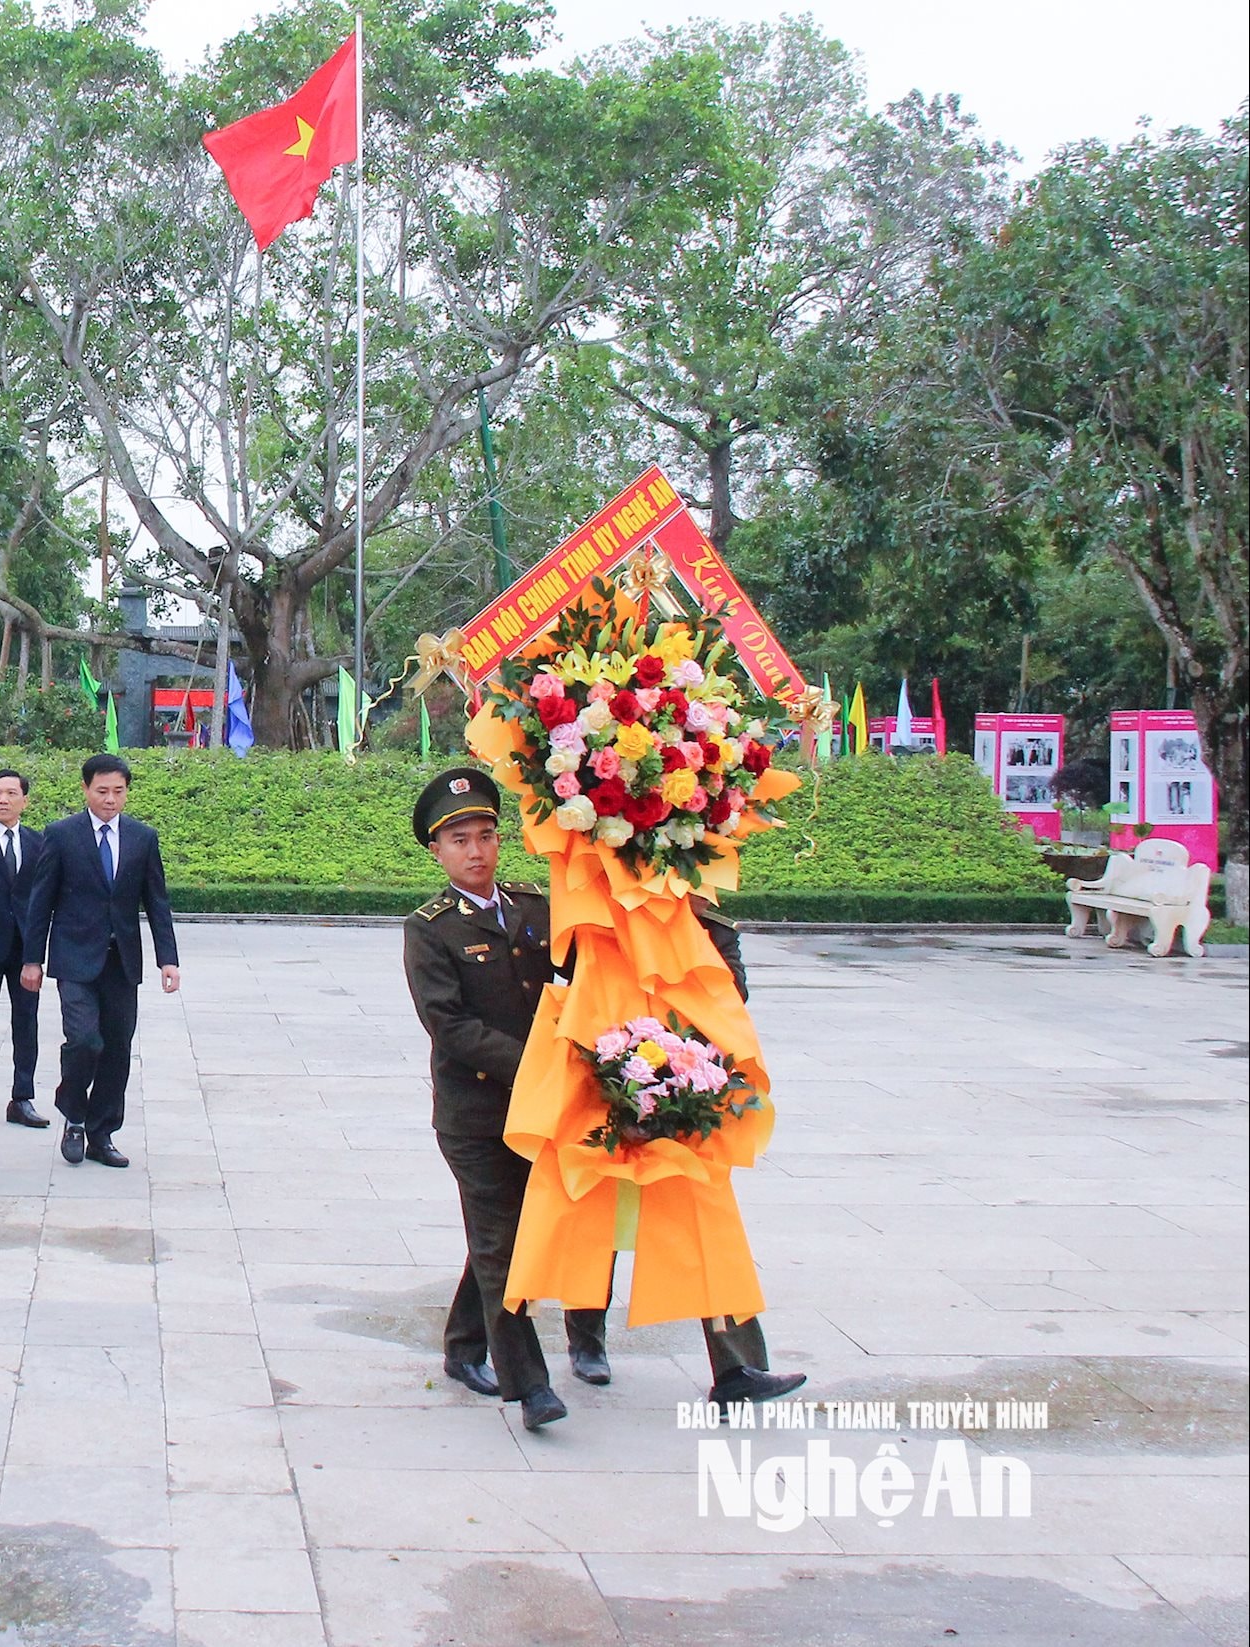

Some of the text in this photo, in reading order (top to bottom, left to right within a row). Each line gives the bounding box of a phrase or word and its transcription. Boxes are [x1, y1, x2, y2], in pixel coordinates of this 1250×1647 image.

[461, 475, 677, 671] BAN NỘI CHÍNH TỈNH ỦY NGHỆ AN
[682, 544, 743, 623] Kính
